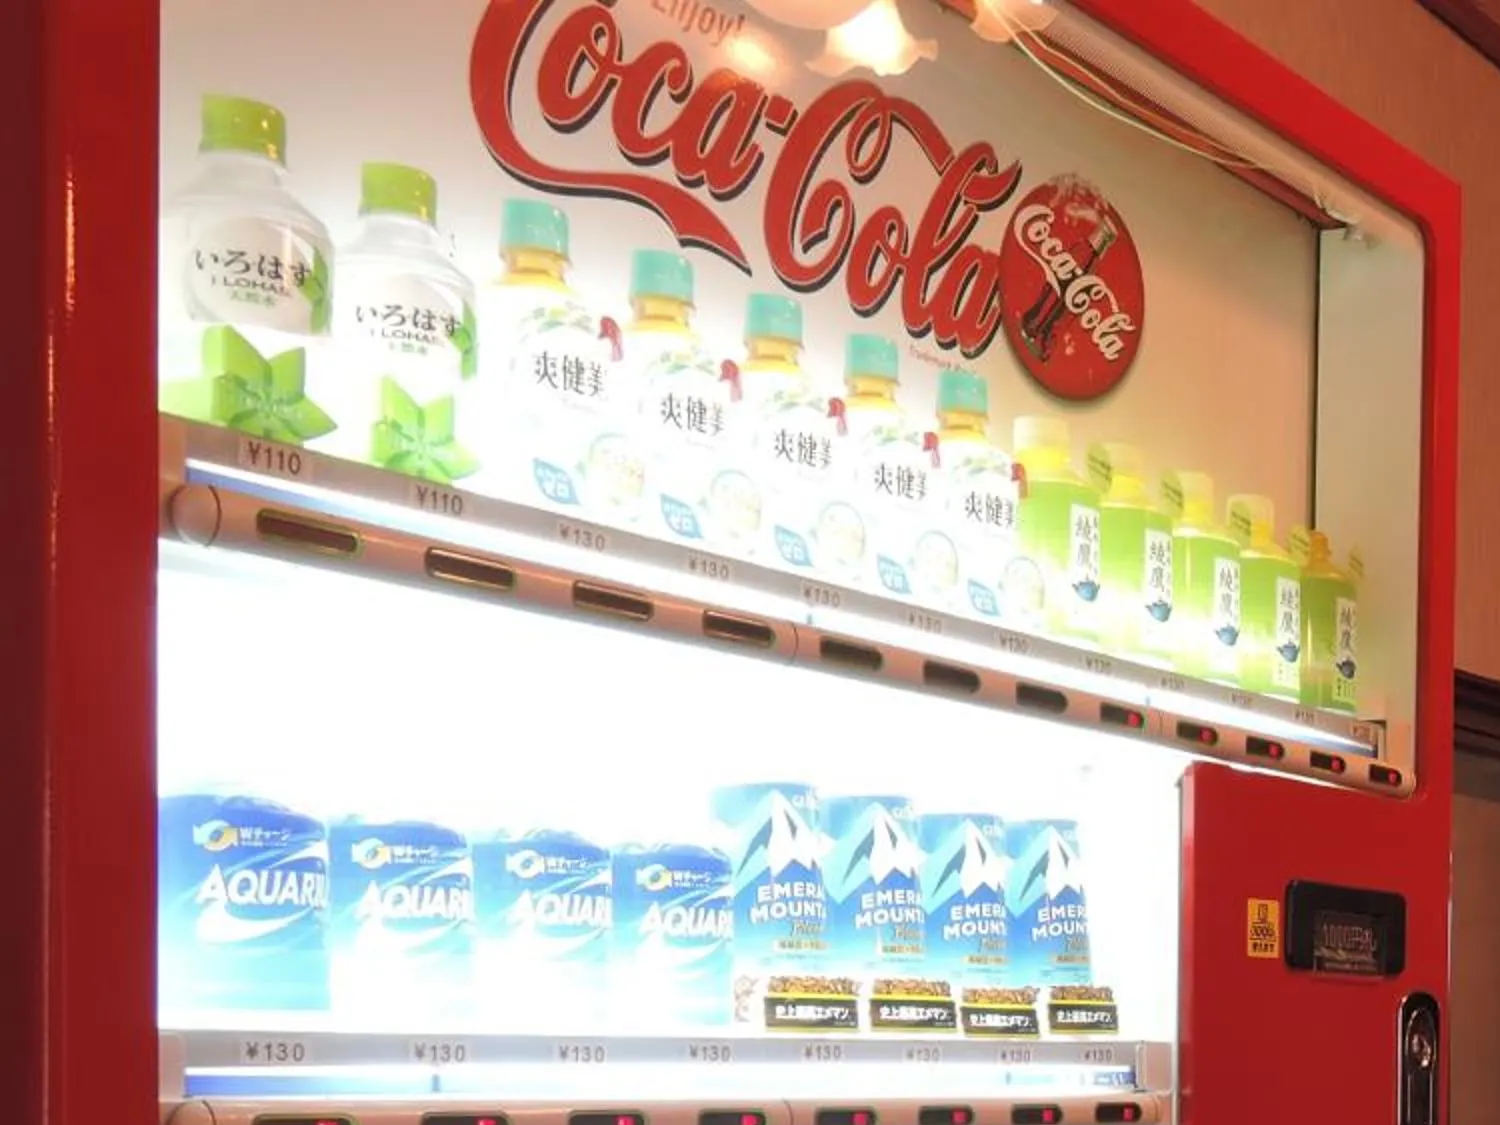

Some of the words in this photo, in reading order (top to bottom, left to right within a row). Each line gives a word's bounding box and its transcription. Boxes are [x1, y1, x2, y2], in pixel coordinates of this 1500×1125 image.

[469, 0, 1023, 359] Coca-Cola
[195, 249, 314, 287] いろはす
[1013, 203, 1137, 361] Coca-Cola
[356, 304, 462, 337] いろはす
[248, 440, 301, 474] ¥110
[415, 484, 464, 516] ¥110
[558, 523, 607, 551] ¥130
[687, 554, 731, 581] ¥130
[246, 1040, 306, 1063] ¥130
[415, 1042, 467, 1063] ¥130
[559, 1044, 606, 1063] ¥130
[690, 1044, 731, 1063] ¥130
[804, 1044, 842, 1061] ¥130
